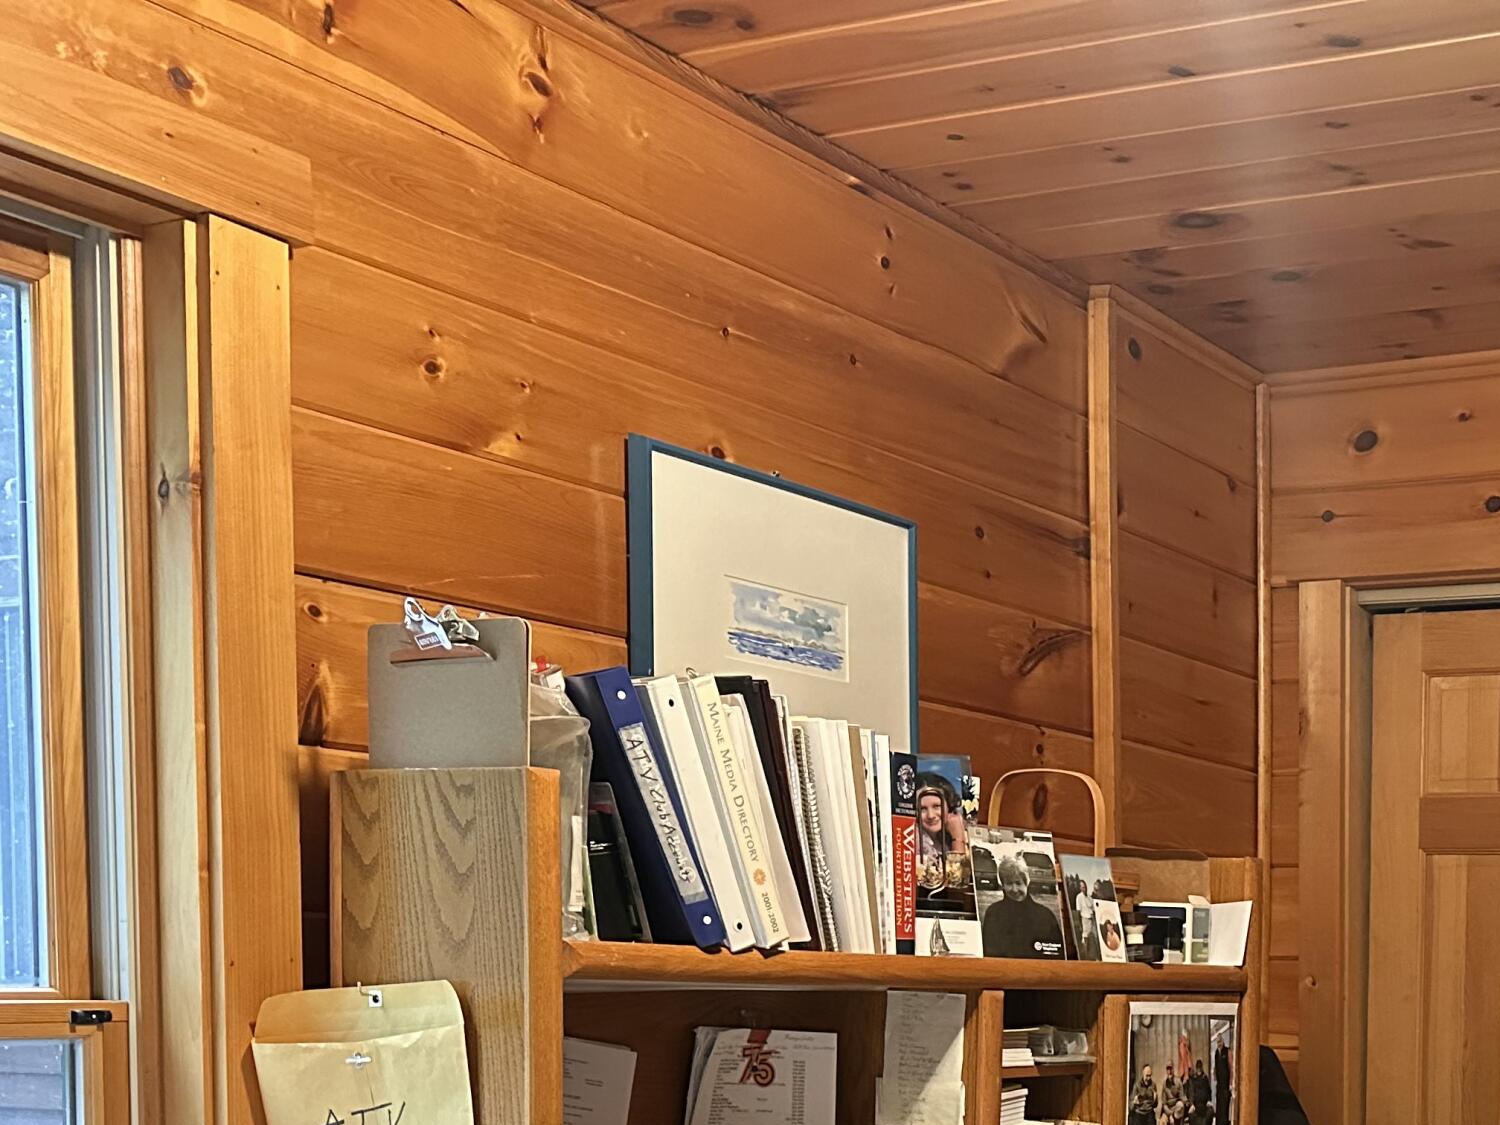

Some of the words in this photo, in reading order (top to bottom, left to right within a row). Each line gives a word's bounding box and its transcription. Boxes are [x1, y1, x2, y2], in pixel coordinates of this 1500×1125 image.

[626, 737, 659, 782] ATV
[649, 787, 671, 821] Club
[707, 702, 725, 744] MAINE
[720, 749, 738, 792] MEDIA
[733, 795, 760, 863] DIRECTORY
[902, 823, 916, 933] WEBSTER'S
[739, 1046, 779, 1087] 75
